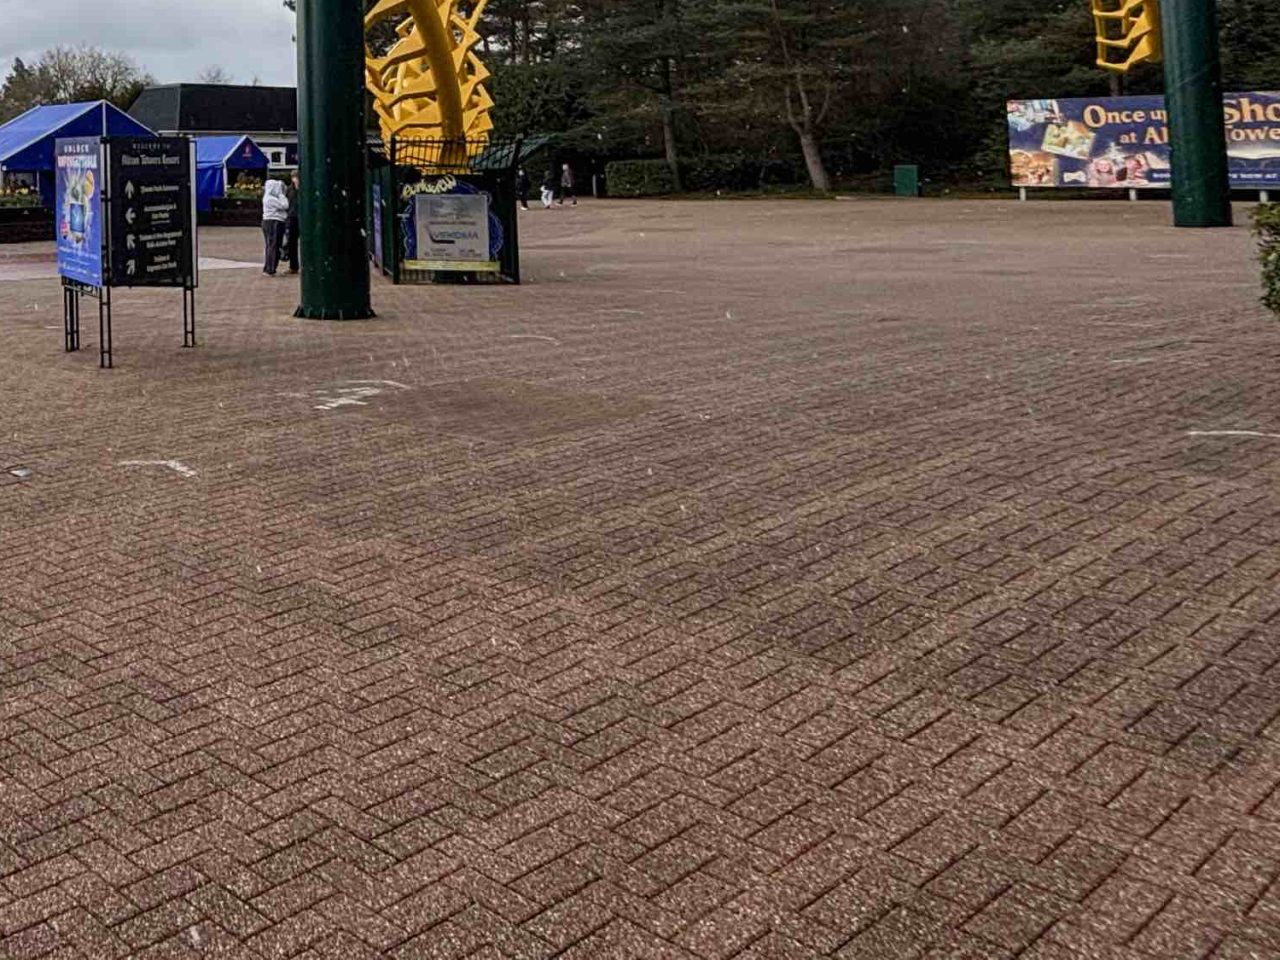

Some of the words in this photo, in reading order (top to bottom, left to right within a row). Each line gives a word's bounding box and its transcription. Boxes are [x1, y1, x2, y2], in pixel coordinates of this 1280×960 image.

[1083, 104, 1145, 128] Once
[1120, 132, 1137, 144] at
[64, 145, 89, 153] UNLOCK
